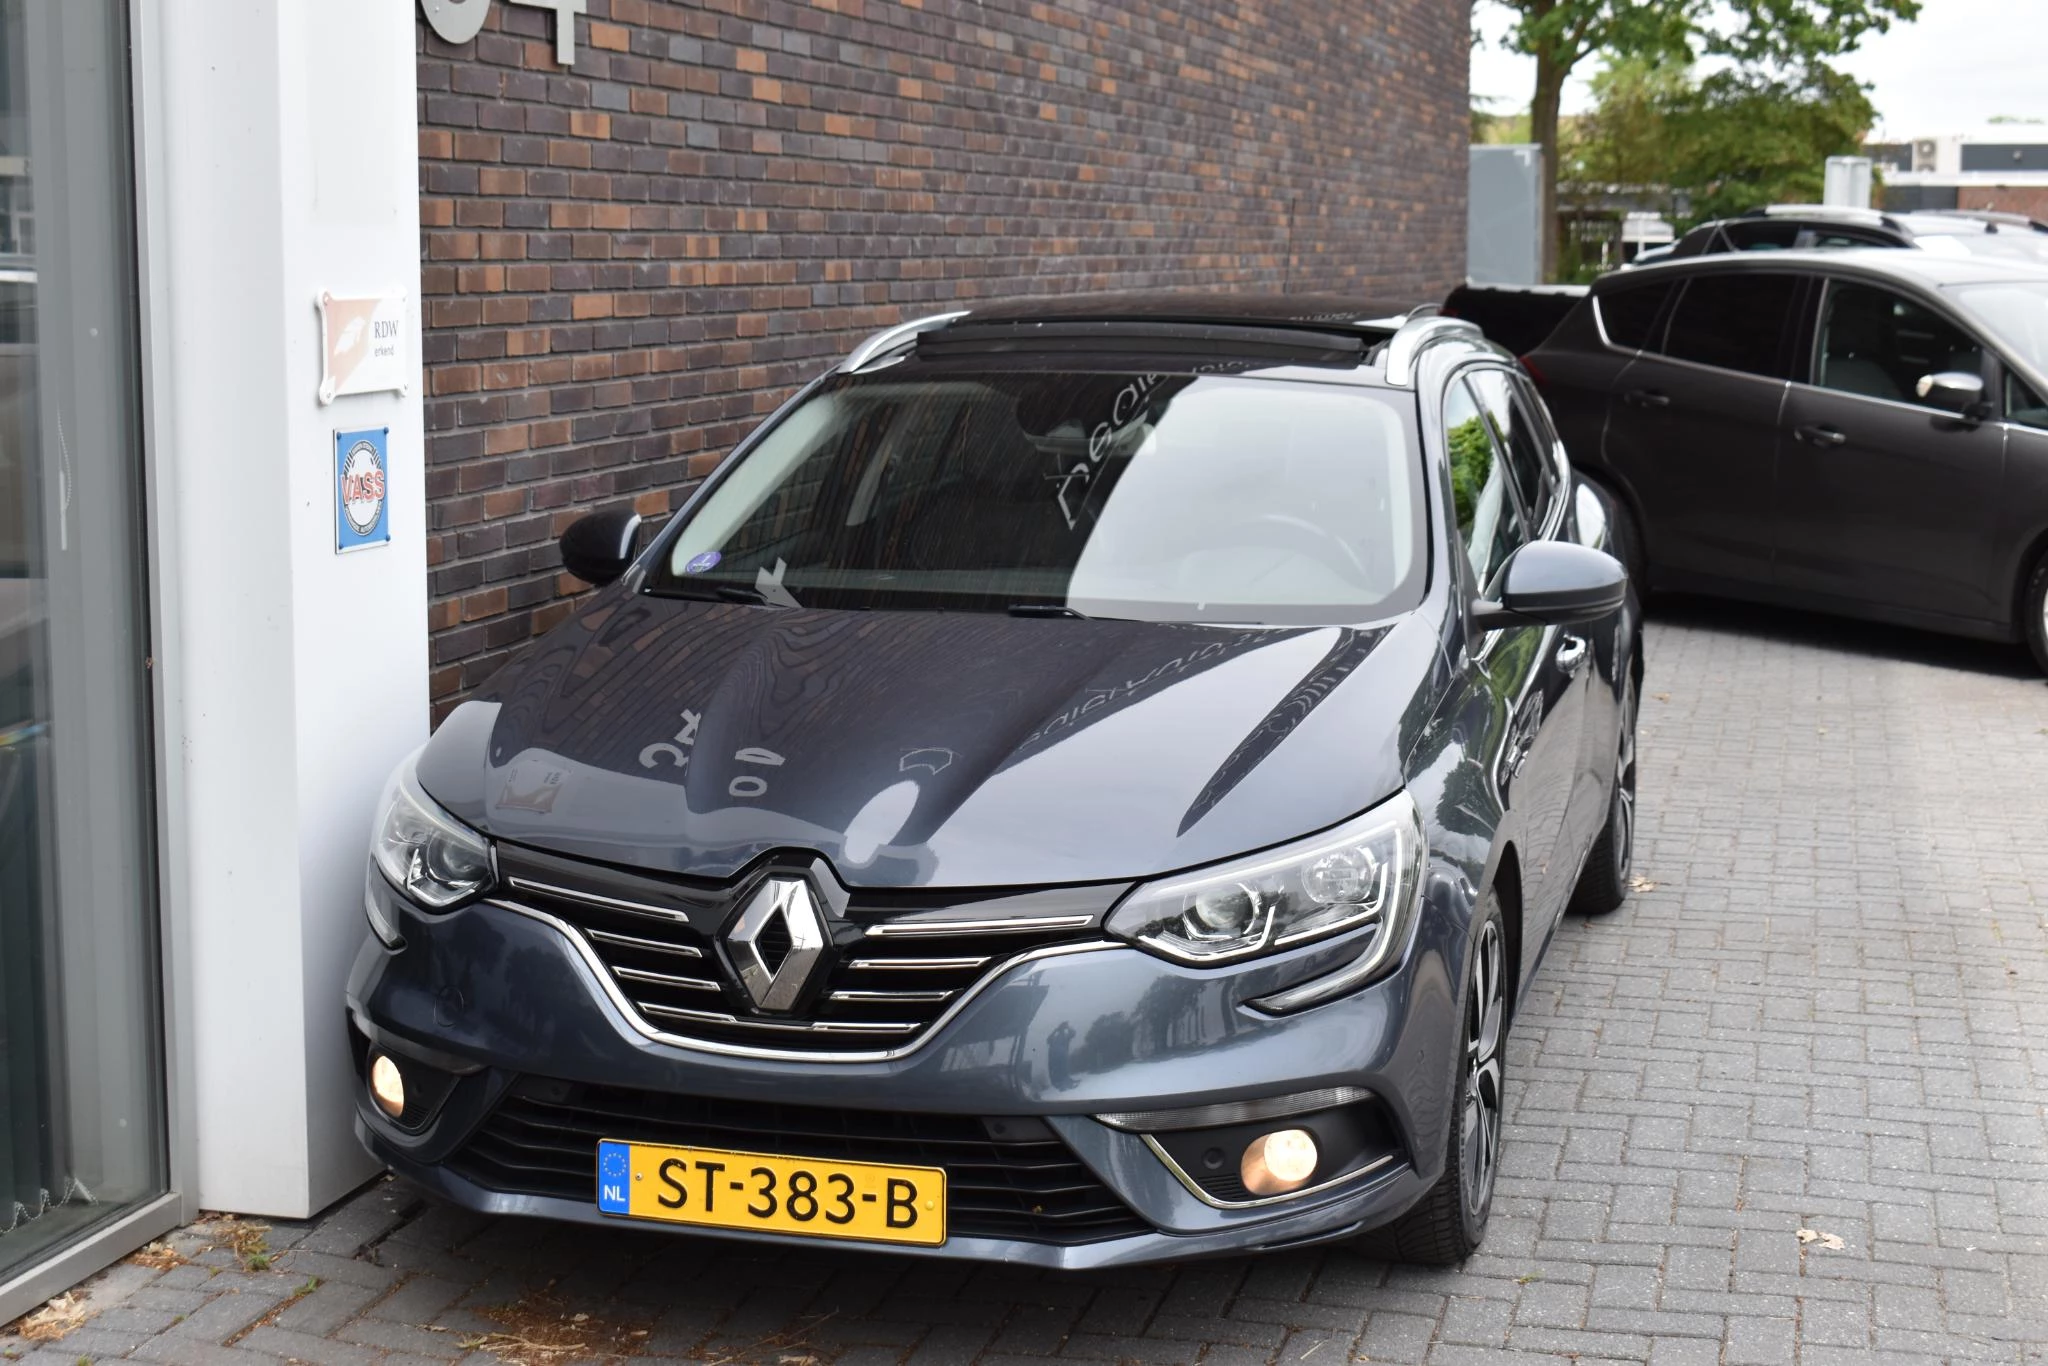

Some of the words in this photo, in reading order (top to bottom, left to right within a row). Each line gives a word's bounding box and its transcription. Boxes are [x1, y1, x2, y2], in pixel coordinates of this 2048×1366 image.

[374, 320, 398, 339] RDW
[374, 345, 394, 357] erkend
[341, 470, 385, 504] VASS
[603, 1184, 626, 1203] NL
[657, 1157, 919, 1229] ST-383-B
